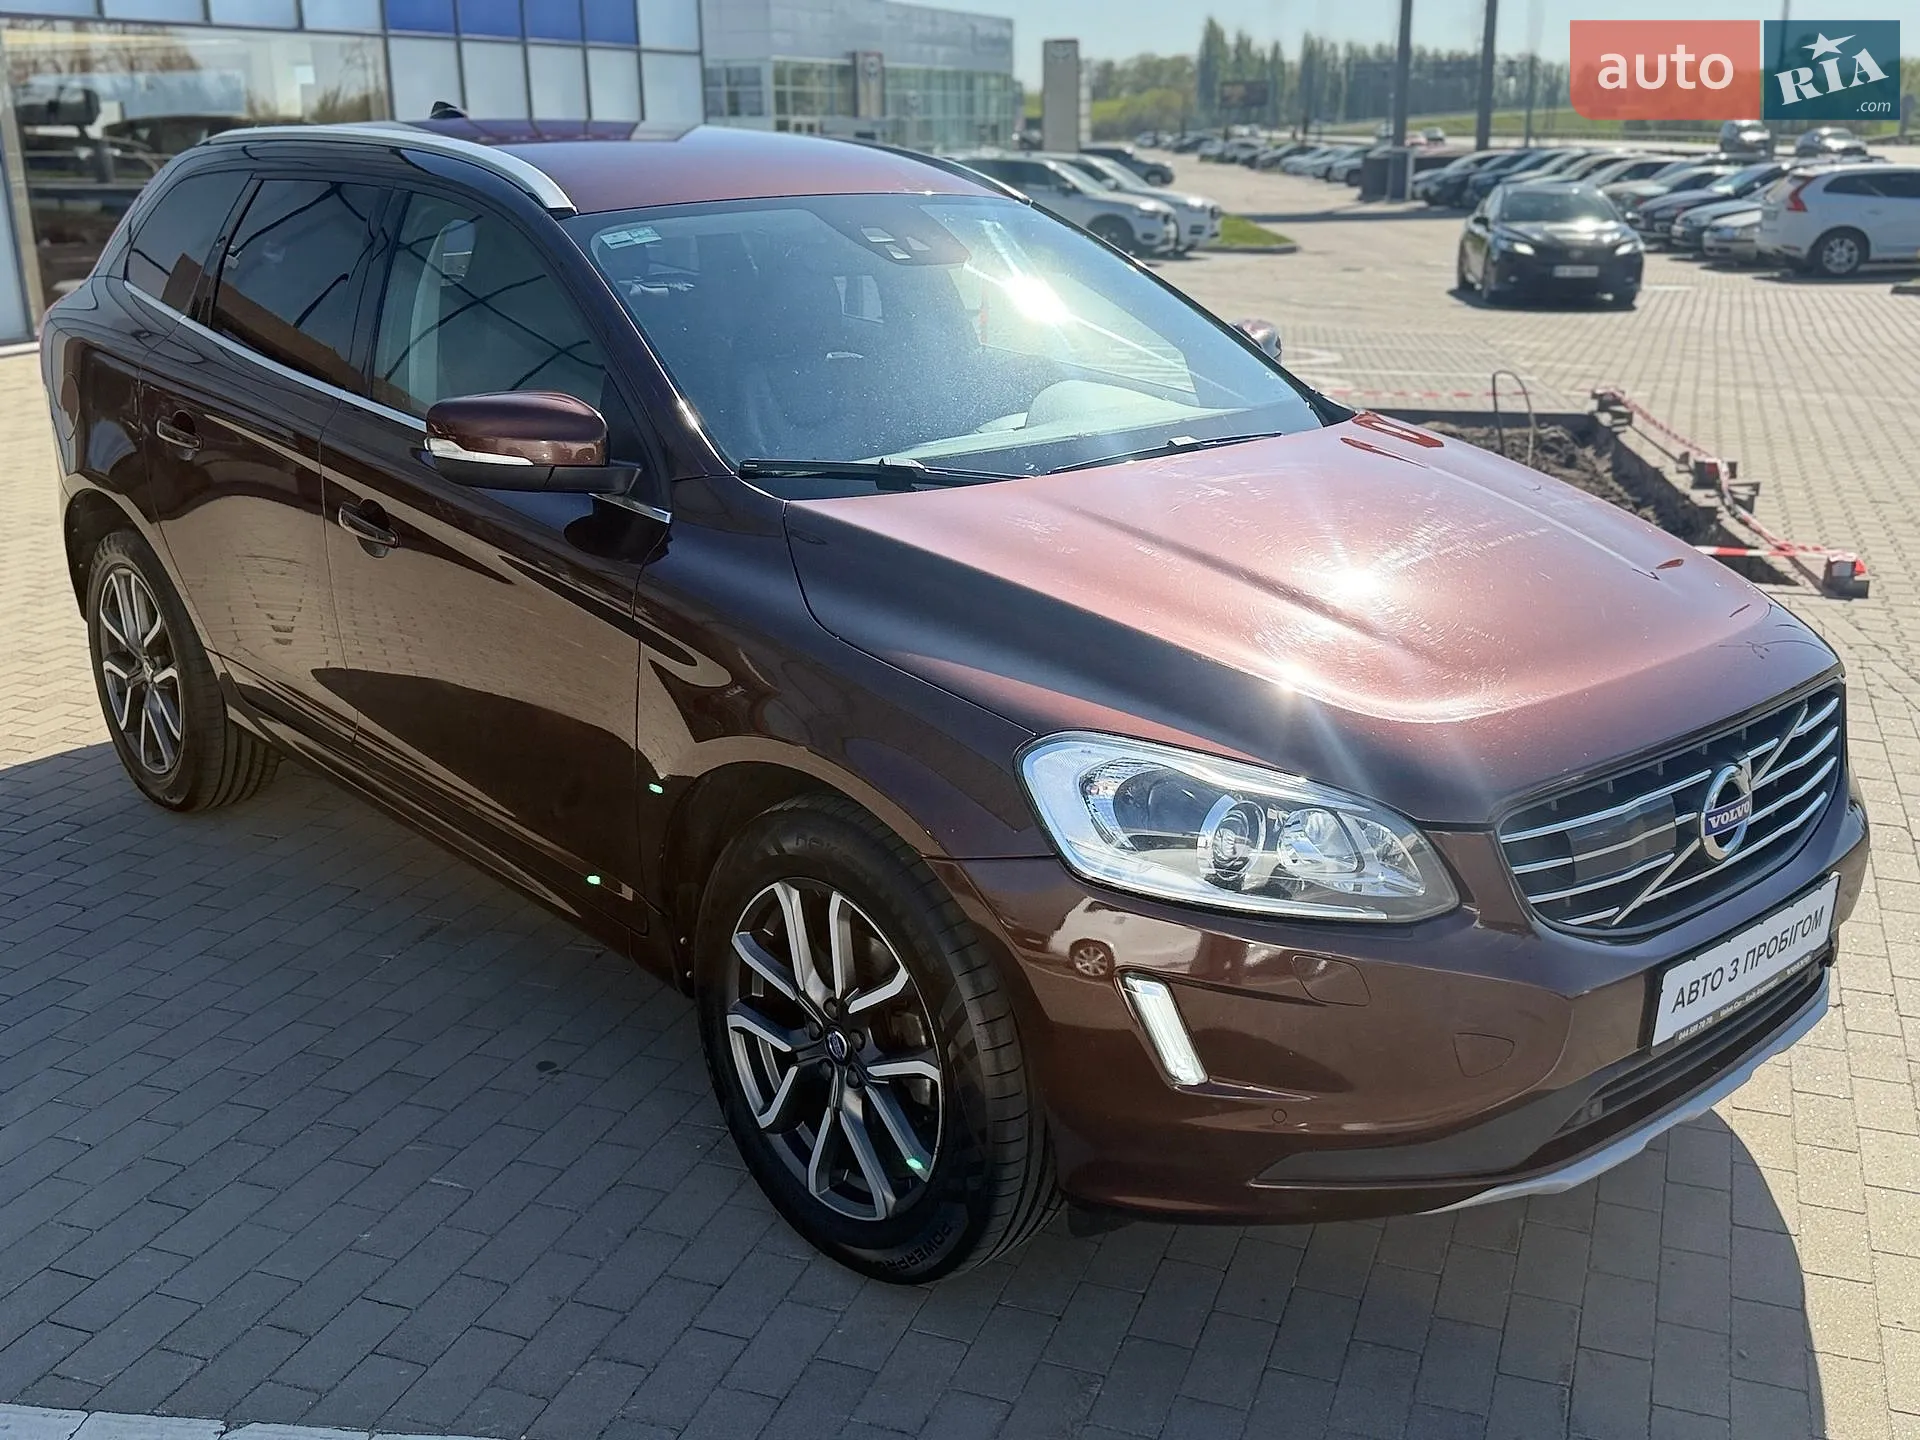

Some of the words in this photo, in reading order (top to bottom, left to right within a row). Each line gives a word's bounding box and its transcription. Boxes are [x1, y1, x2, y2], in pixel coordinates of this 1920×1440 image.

[1708, 801, 1750, 828] VOLVO
[1671, 966, 1724, 1013] АВТО
[1743, 905, 1825, 974] ПРОБІГОМ
